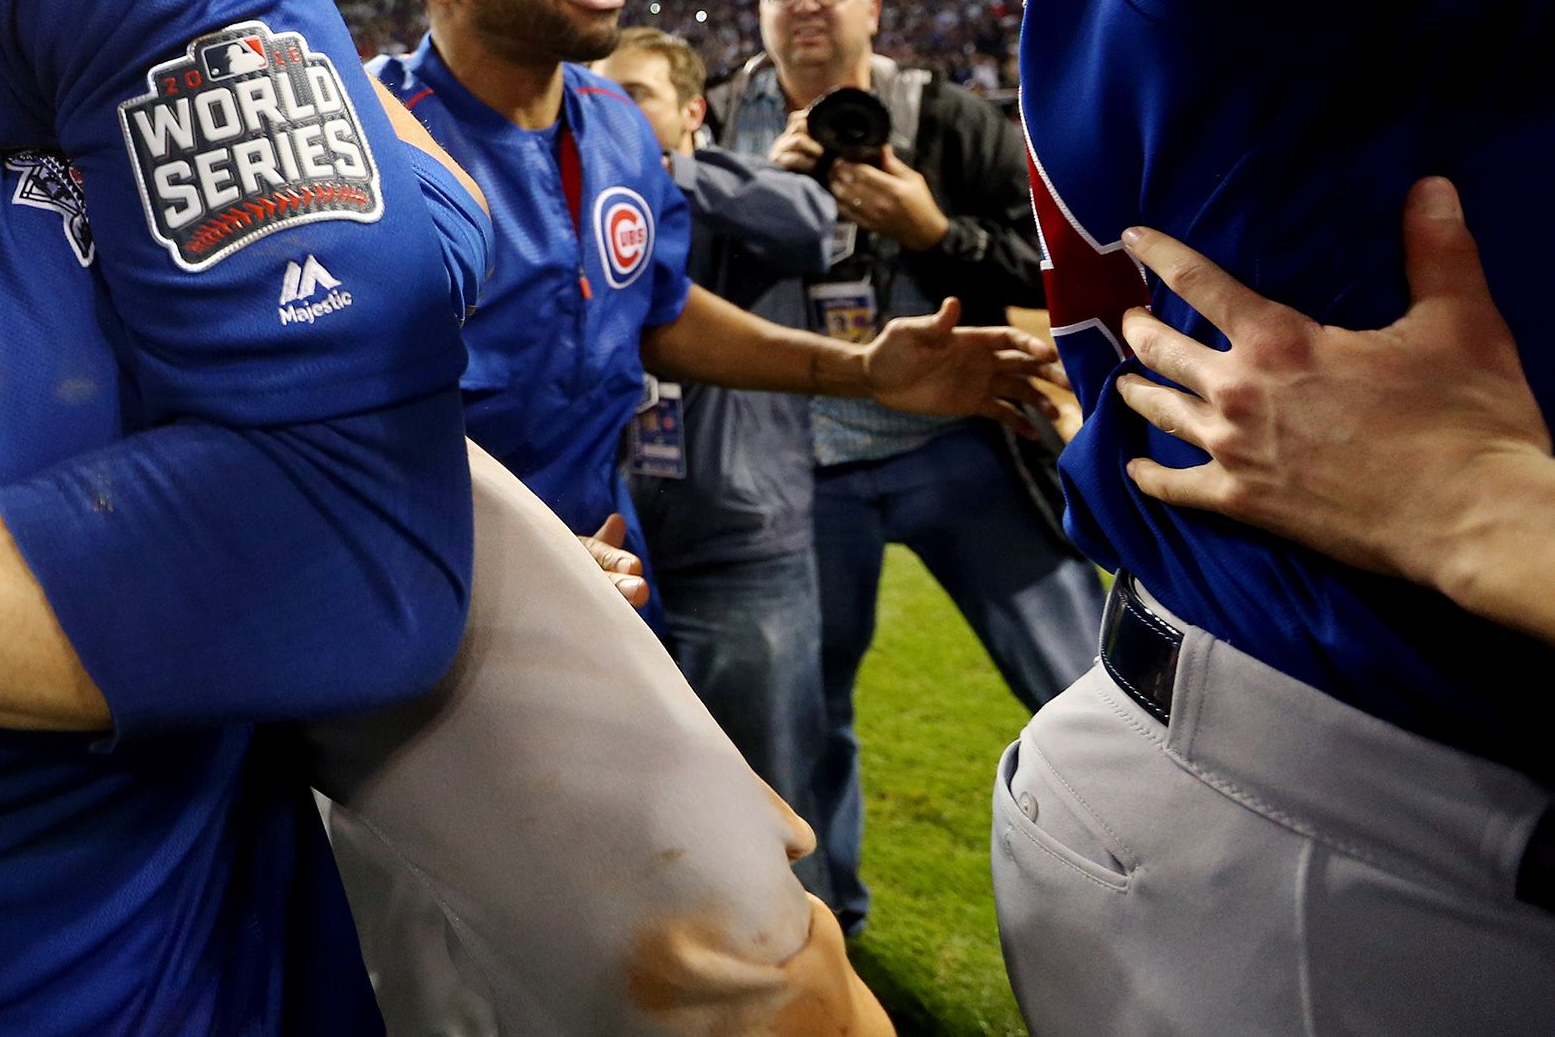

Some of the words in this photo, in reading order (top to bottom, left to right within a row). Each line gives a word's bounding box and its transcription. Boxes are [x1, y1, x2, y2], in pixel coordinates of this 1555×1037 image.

[133, 66, 344, 158] WORLD
[153, 118, 368, 230] SERIES
[277, 288, 355, 327] Majestic
